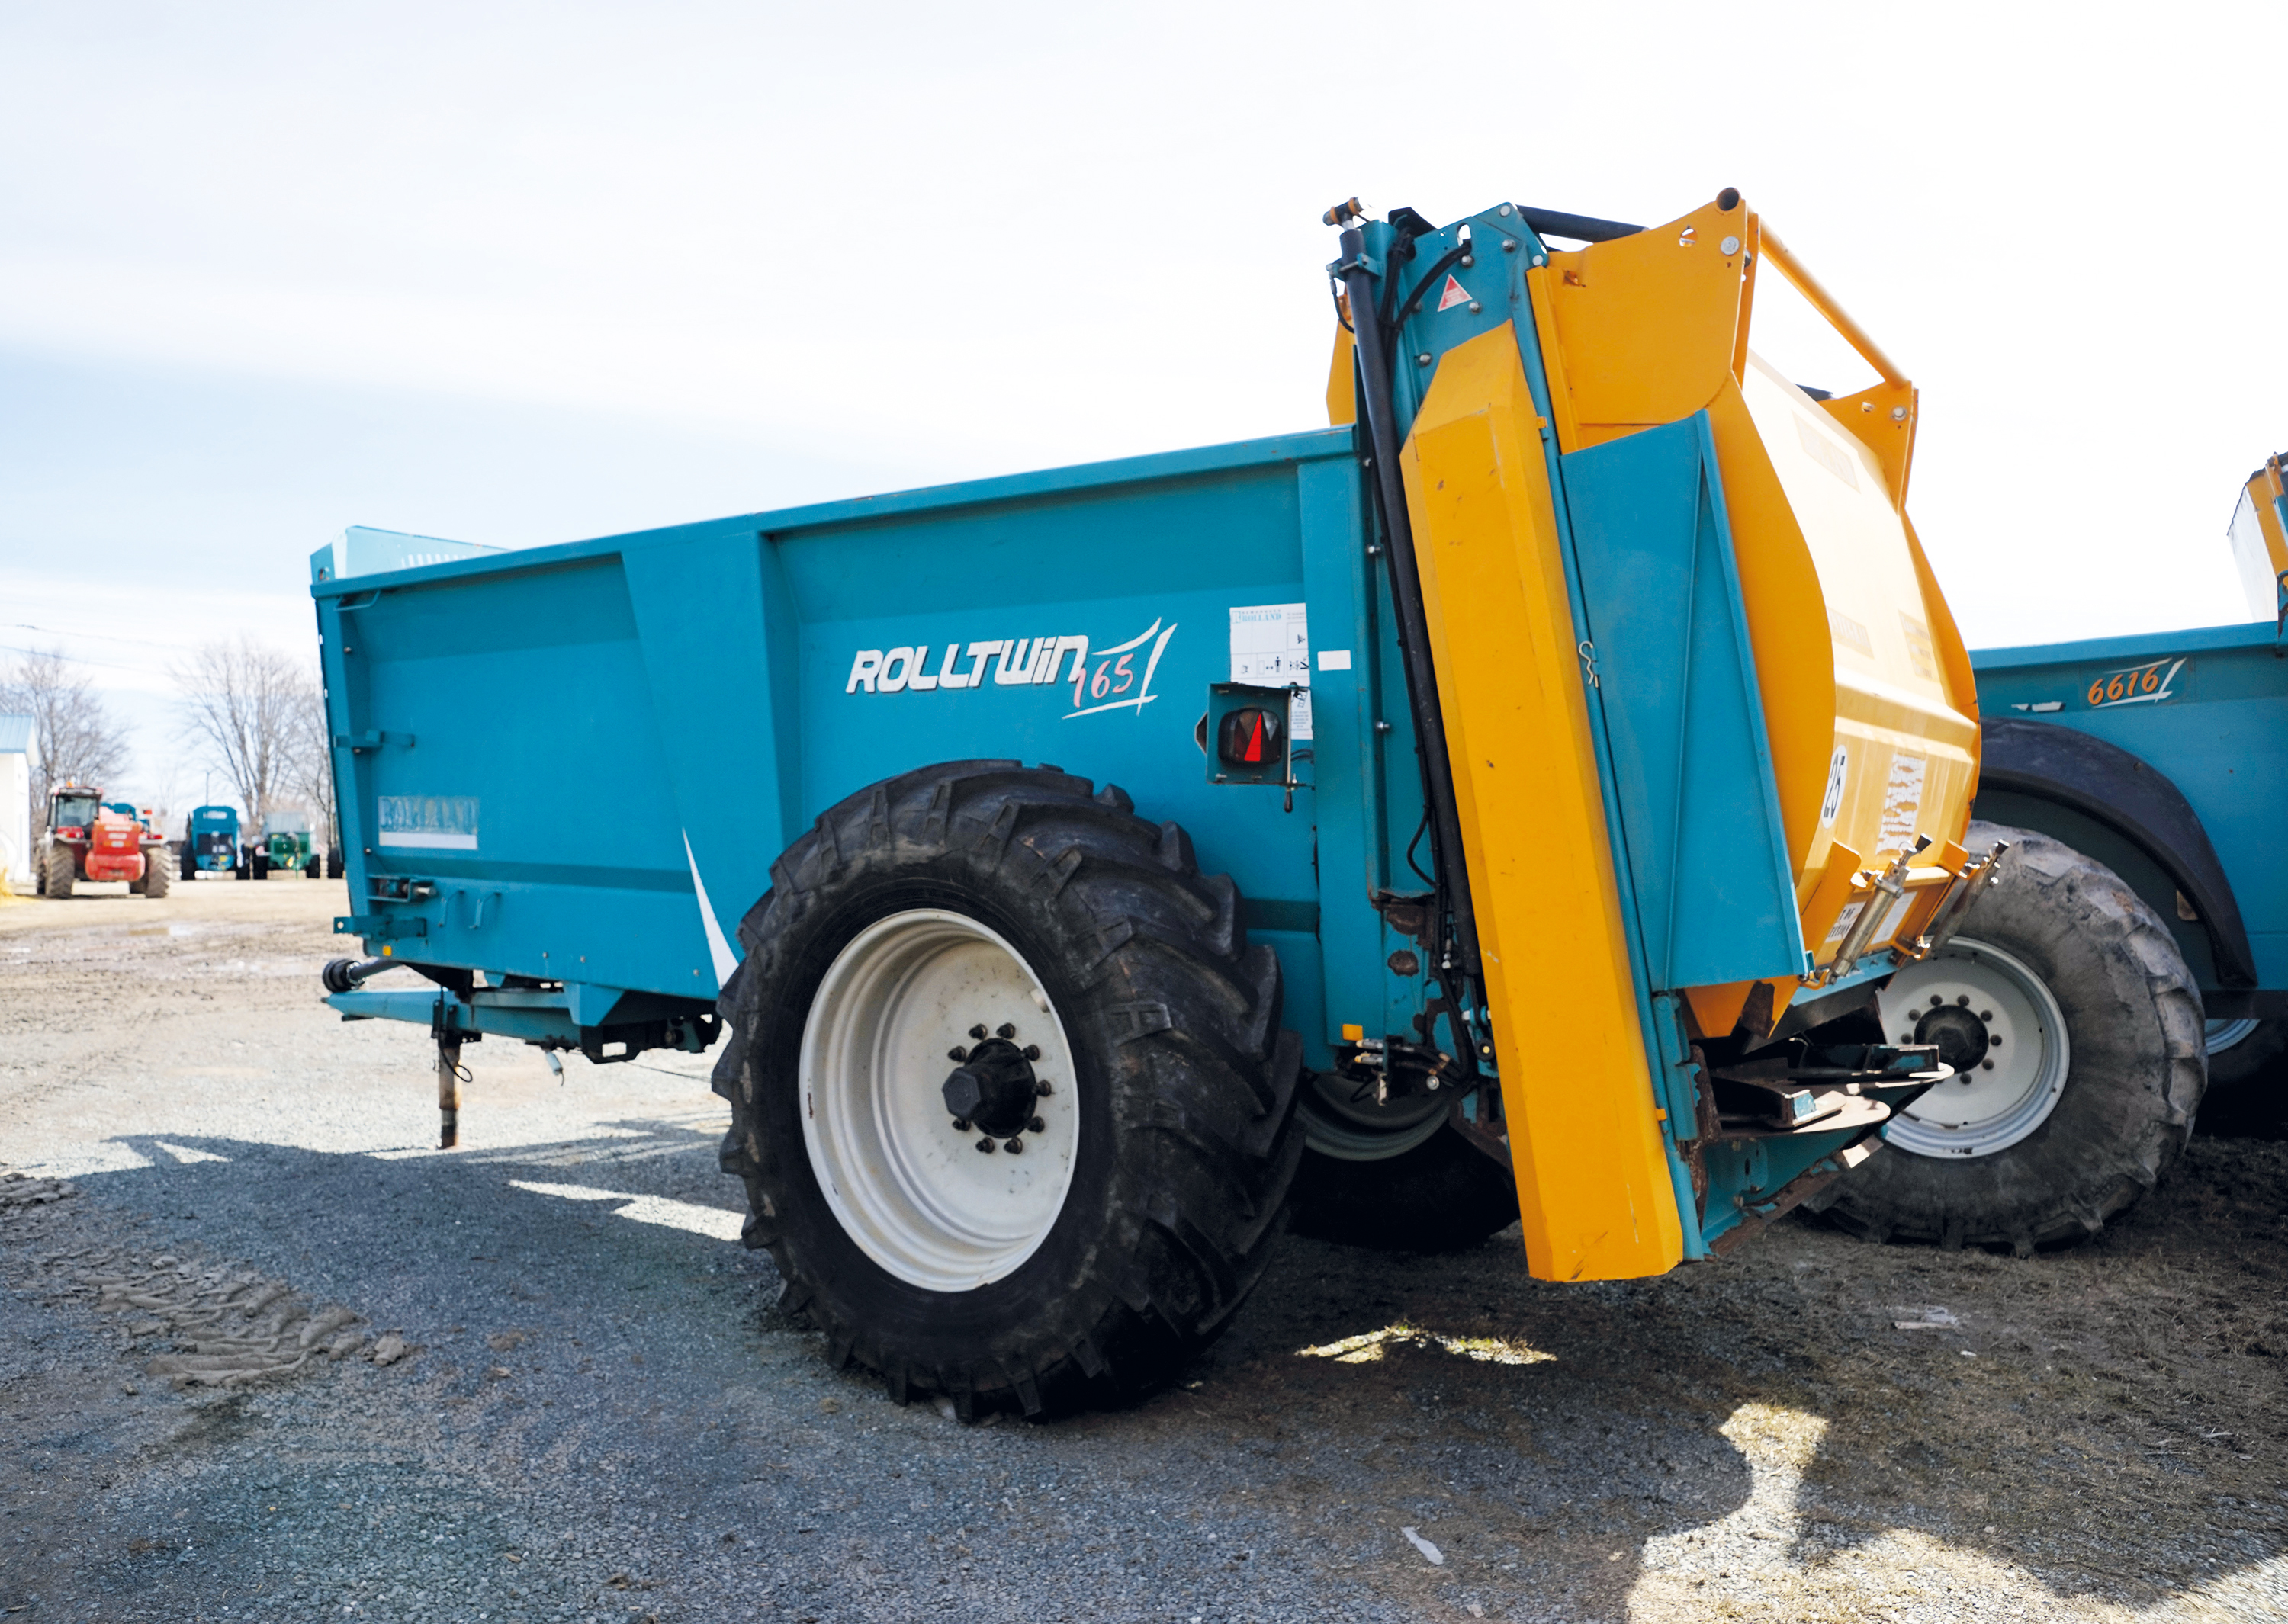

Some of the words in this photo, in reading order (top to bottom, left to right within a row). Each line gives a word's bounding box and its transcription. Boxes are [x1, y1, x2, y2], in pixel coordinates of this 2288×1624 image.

[1073, 653, 1135, 708] 165
[2088, 666, 2159, 705] 6616
[1823, 753, 1846, 819] 25
